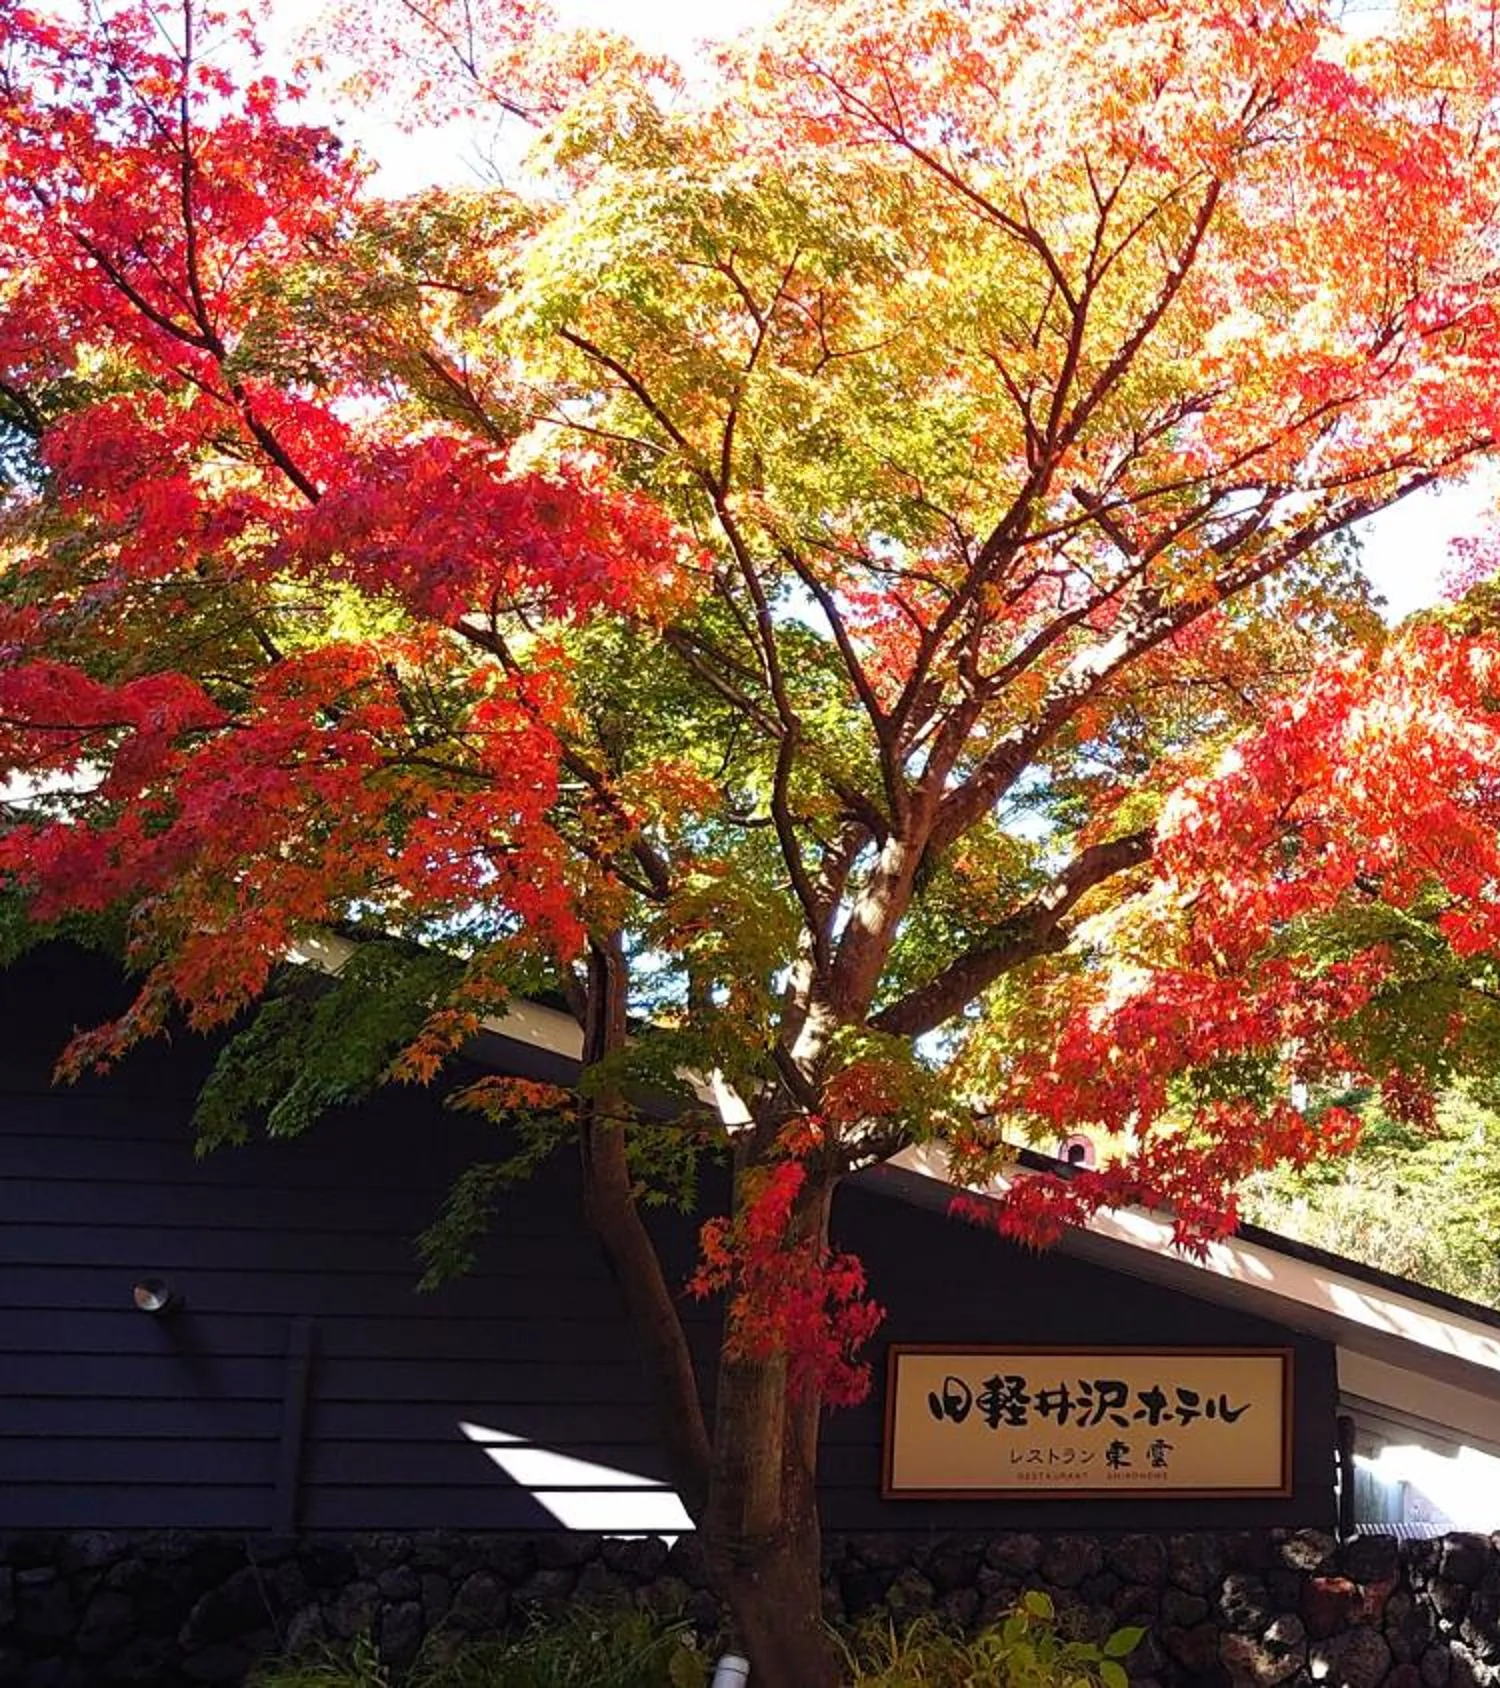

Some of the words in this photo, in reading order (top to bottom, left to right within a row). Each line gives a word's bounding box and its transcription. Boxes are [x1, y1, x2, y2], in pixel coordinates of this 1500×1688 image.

[927, 1374, 1251, 1429] 旧軽井沢ホテル
[1010, 1447, 1095, 1465] レストラン
